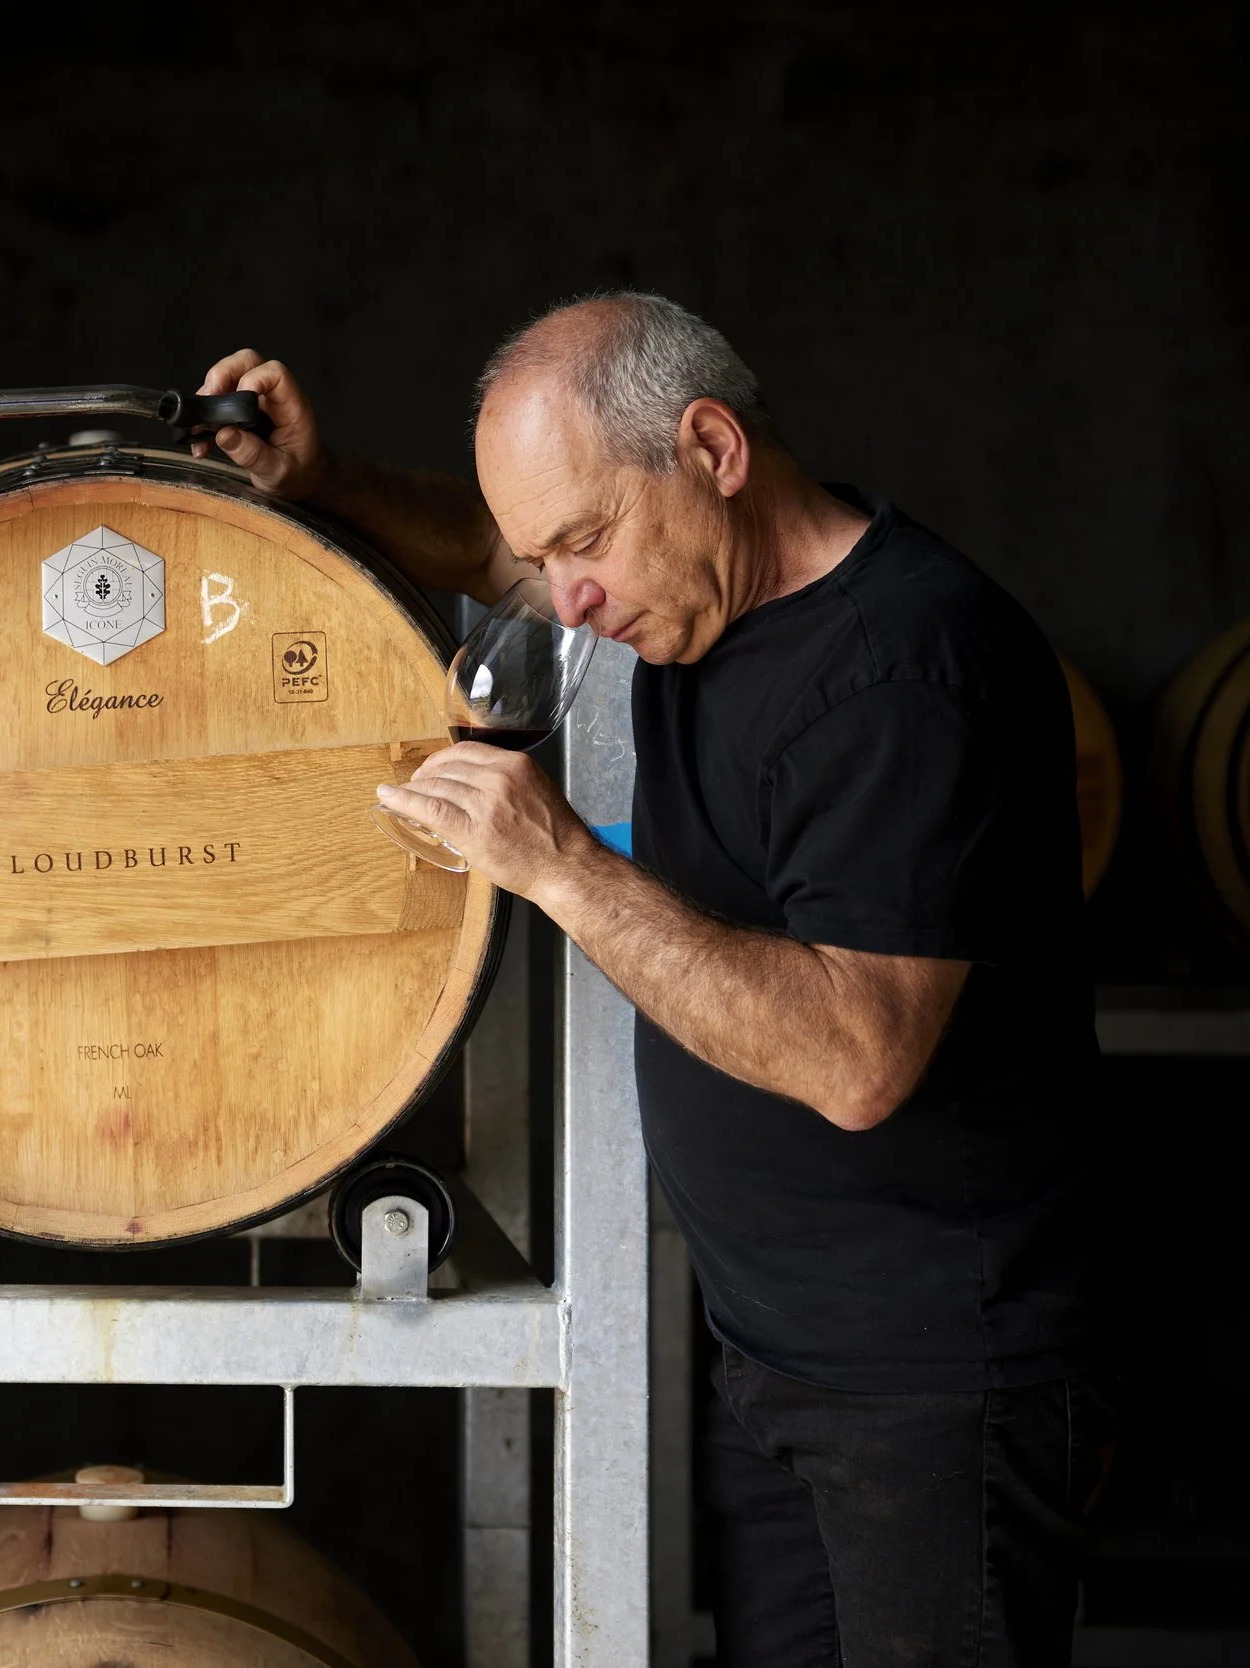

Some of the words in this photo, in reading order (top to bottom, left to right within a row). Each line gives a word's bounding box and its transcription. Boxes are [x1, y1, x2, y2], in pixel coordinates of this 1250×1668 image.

[74, 558, 98, 590] SEGUIN
[101, 556, 132, 589] MOREAU
[200, 572, 241, 645] B
[282, 676, 319, 688] PEFC
[77, 1043, 130, 1060] FRENCH
[134, 1042, 164, 1058] OAK
